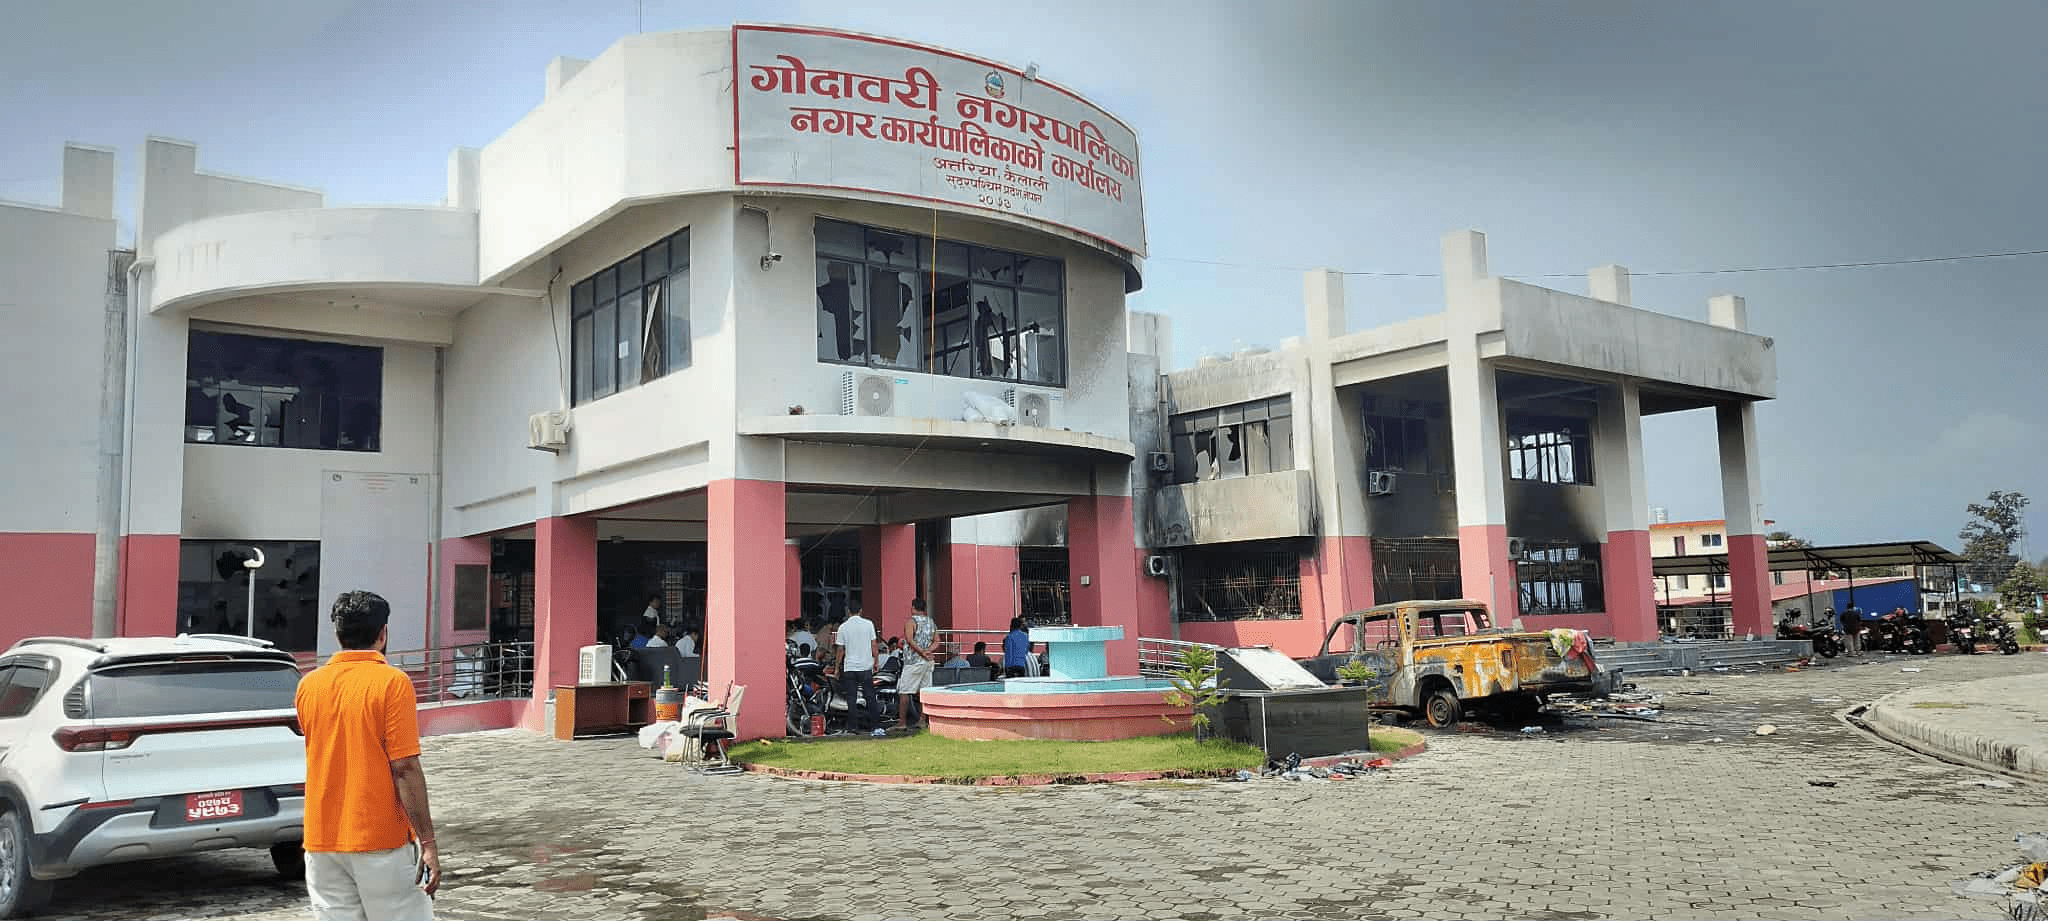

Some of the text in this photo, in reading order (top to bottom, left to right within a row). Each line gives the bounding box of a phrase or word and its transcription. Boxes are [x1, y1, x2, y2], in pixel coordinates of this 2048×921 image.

[750, 54, 1134, 180] गोदावरी नगरपालिका
[789, 106, 1122, 203] नगर कार्यपालिकाको कार्यालय
[1003, 164, 1048, 191] कैलाली
